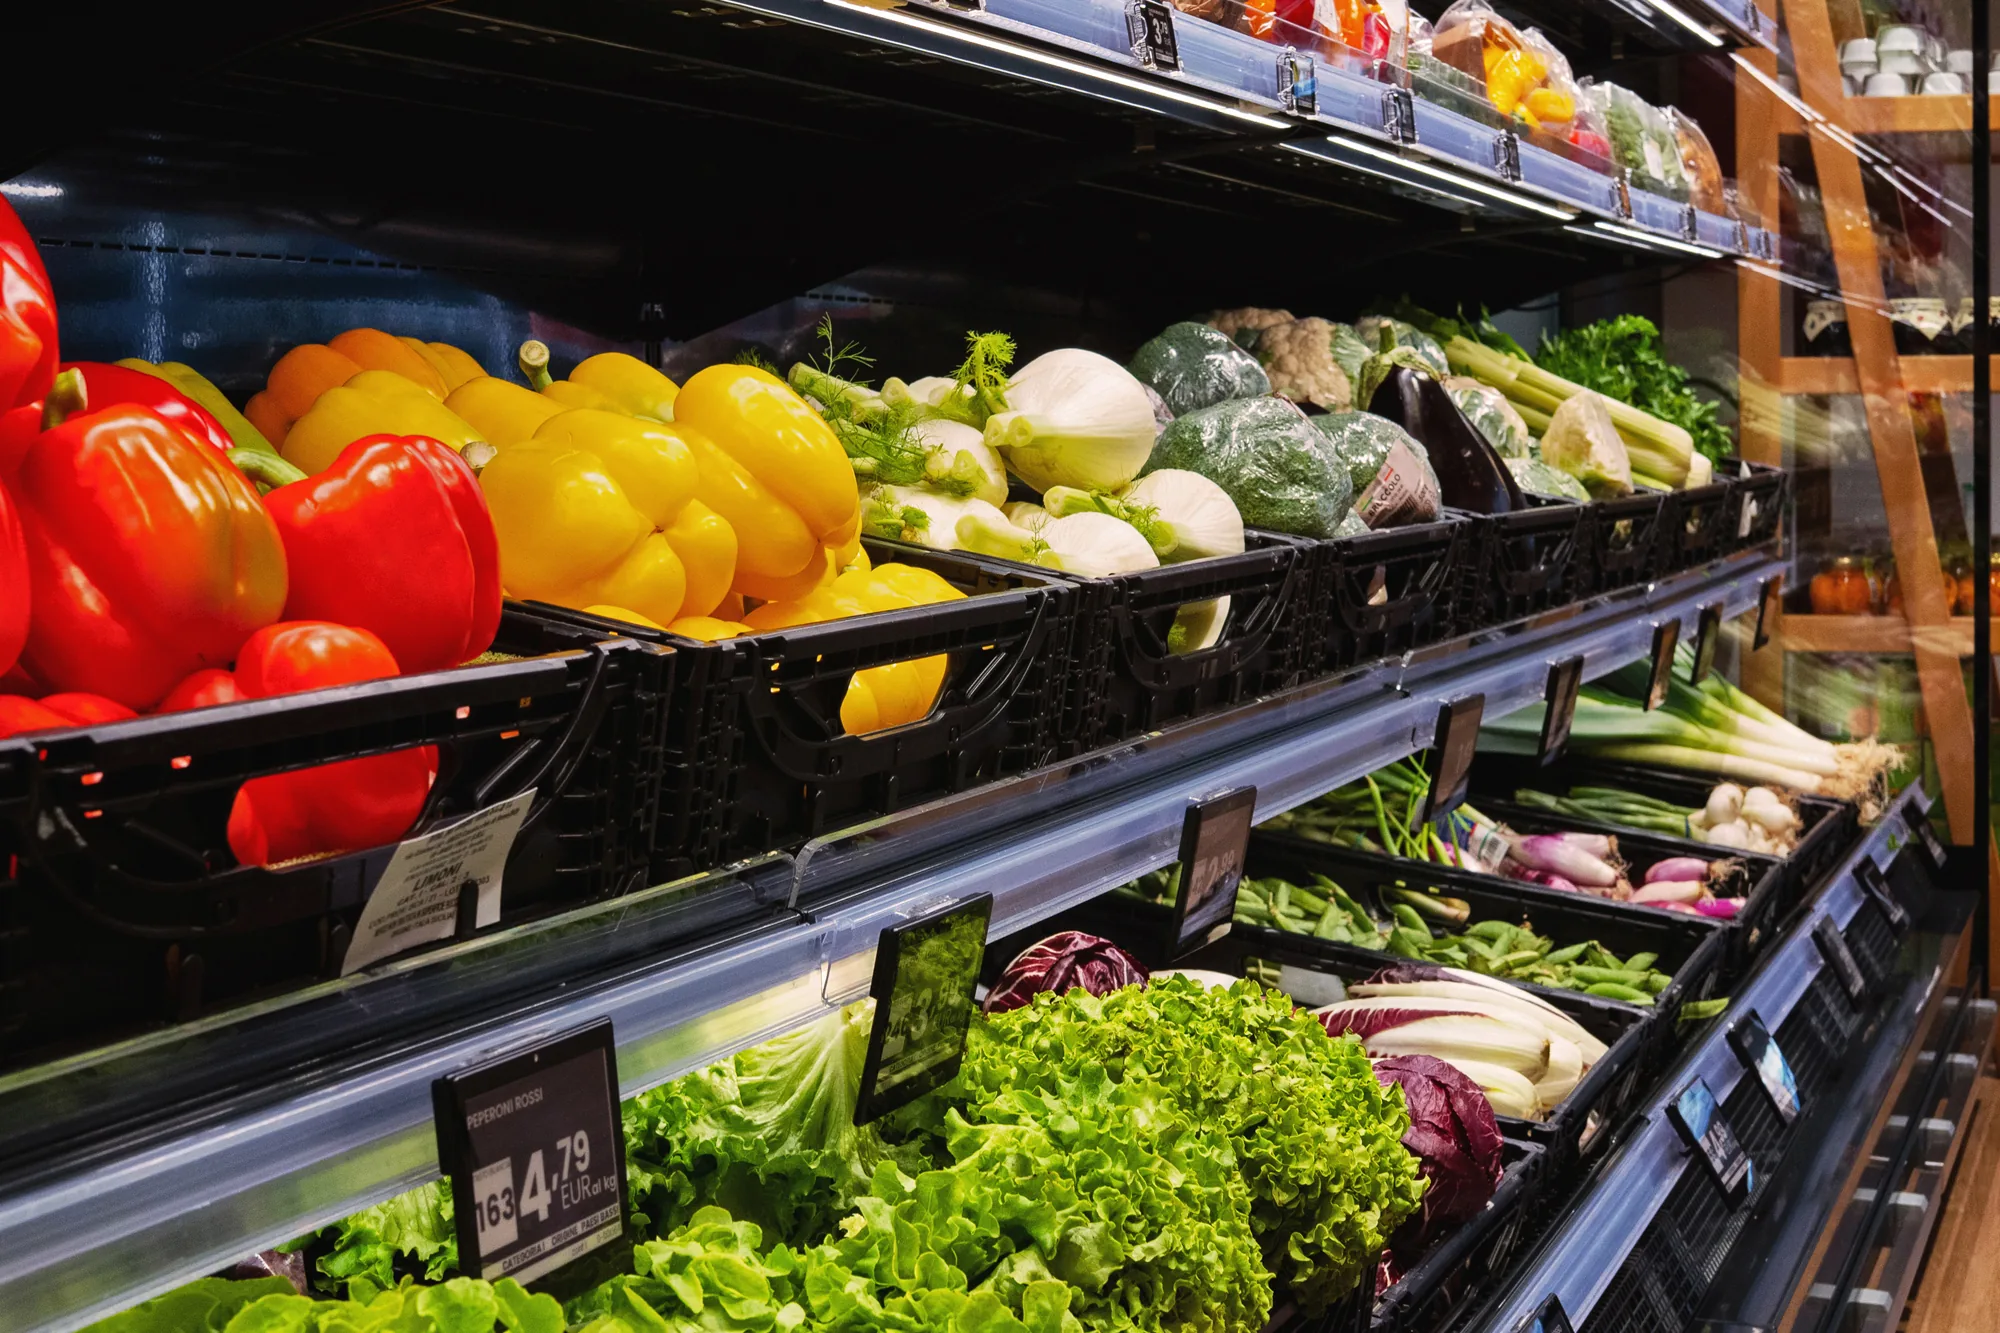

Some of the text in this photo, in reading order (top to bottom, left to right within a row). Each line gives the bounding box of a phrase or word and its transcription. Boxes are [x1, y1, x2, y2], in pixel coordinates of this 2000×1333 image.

[412, 861, 463, 892] LIMONI
[467, 1087, 544, 1130] PEPERONI ROSSI
[475, 1187, 515, 1232] 163
[560, 1175, 592, 1210] EUR
[502, 1244, 542, 1271] CATEGORIA
[581, 1216, 600, 1234] PAESI
[600, 1206, 619, 1222] BASSI
